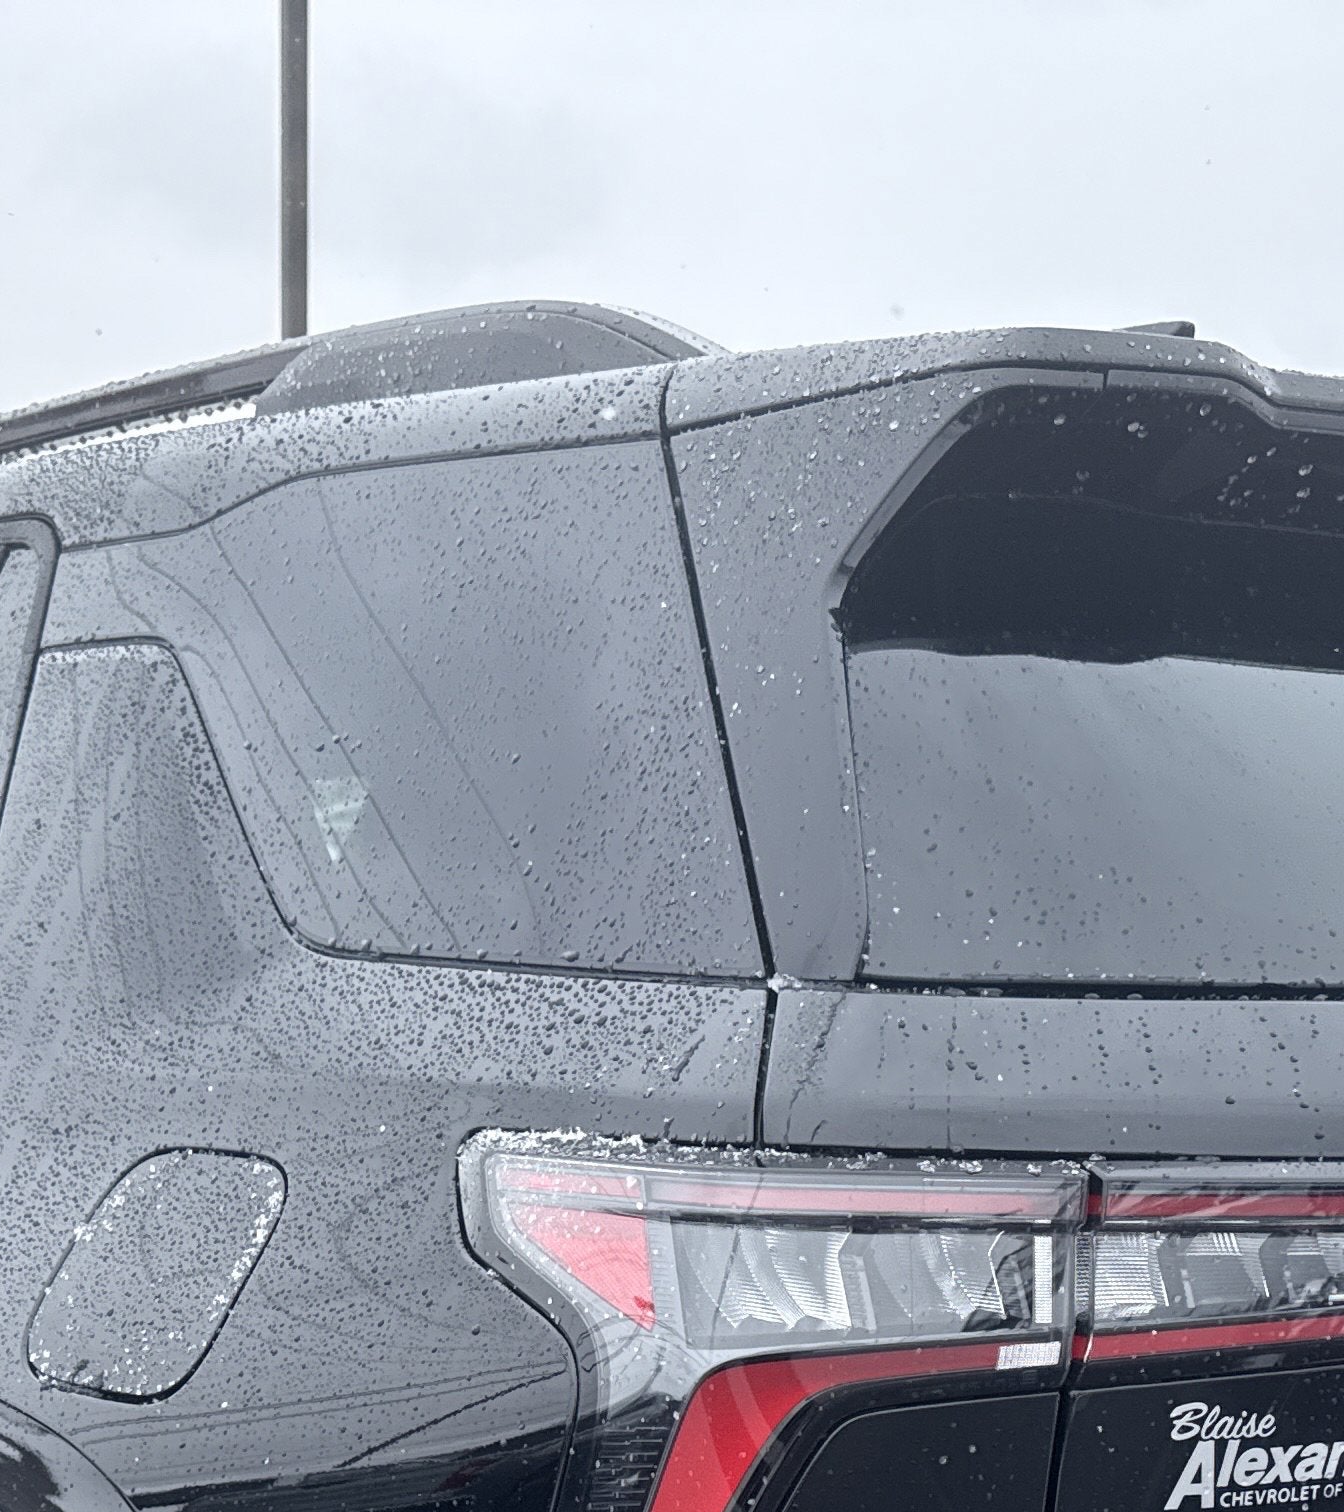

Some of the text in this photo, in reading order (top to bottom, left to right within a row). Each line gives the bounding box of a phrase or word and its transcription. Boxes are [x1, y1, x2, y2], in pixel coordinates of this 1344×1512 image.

[1170, 1401, 1277, 1441] Blaise
[1219, 1483, 1321, 1508] CHEVROLET
[1323, 1482, 1344, 1498] OF
